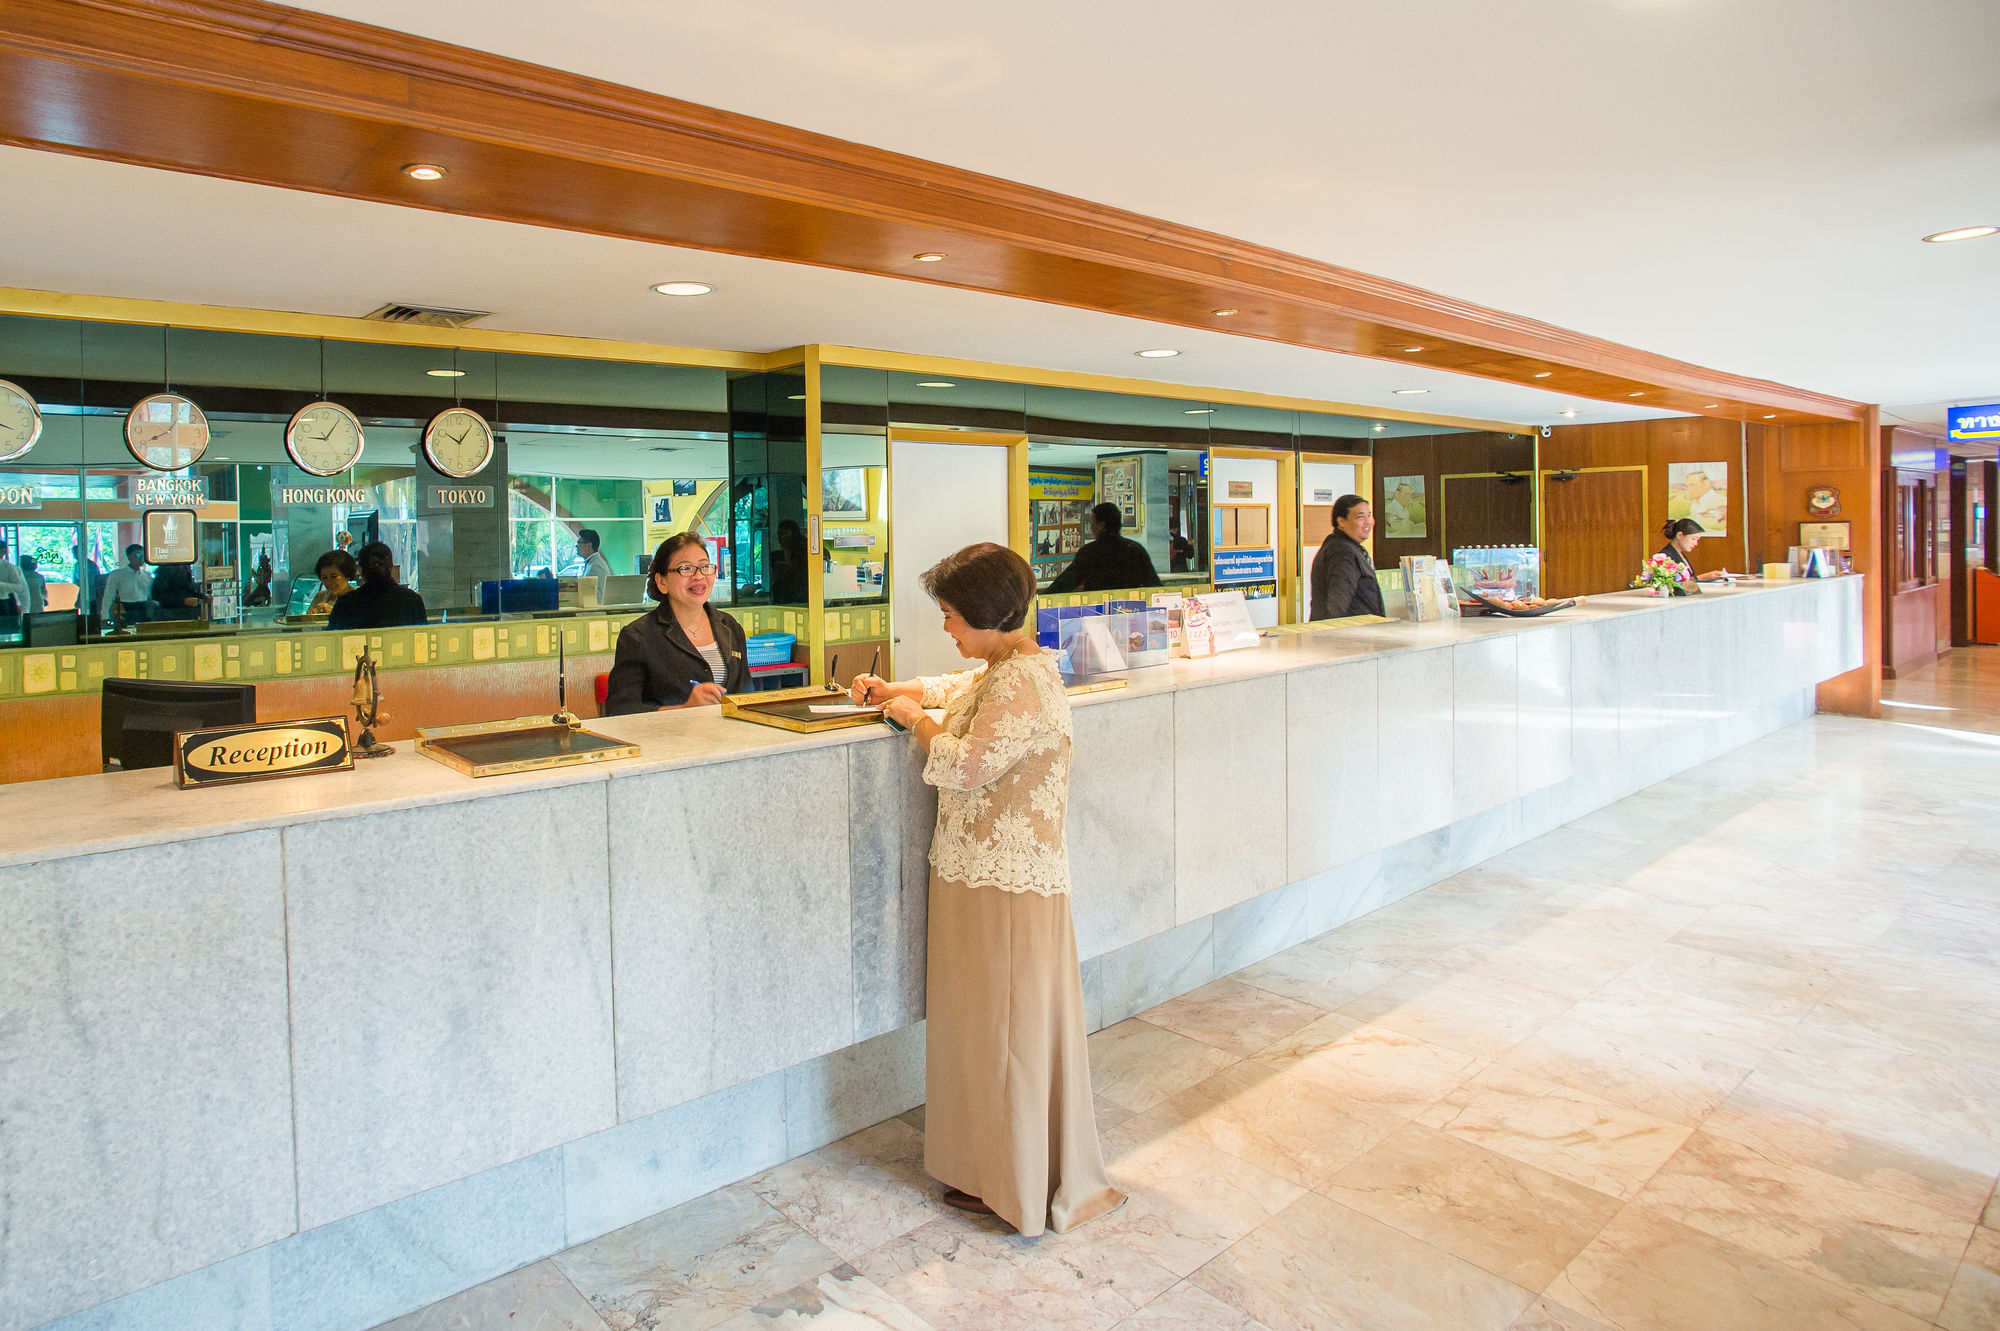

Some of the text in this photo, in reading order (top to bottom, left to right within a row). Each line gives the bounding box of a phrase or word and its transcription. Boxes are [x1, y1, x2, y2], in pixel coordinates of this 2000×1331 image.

[16, 403, 25, 413] 2
[322, 411, 330, 420] 12
[21, 417, 30, 428] 3
[194, 428, 201, 438] 3
[344, 424, 351, 433] 2
[475, 428, 482, 436] 2
[15, 431, 24, 440] 4
[4, 440, 13, 451] 5
[301, 447, 307, 456] 8
[344, 448, 350, 456] 4
[438, 450, 444, 459] 8
[475, 450, 482, 458] 4
[311, 455, 317, 464] 7
[322, 459, 329, 467] 6
[447, 458, 453, 467] 7
[468, 458, 474, 467] 5
[137, 479, 202, 491] BANGKOK
[135, 493, 205, 506] NEW YORK
[282, 488, 365, 504] HONG KONG
[437, 489, 486, 504] TOKYO
[209, 737, 328, 766] Reception
